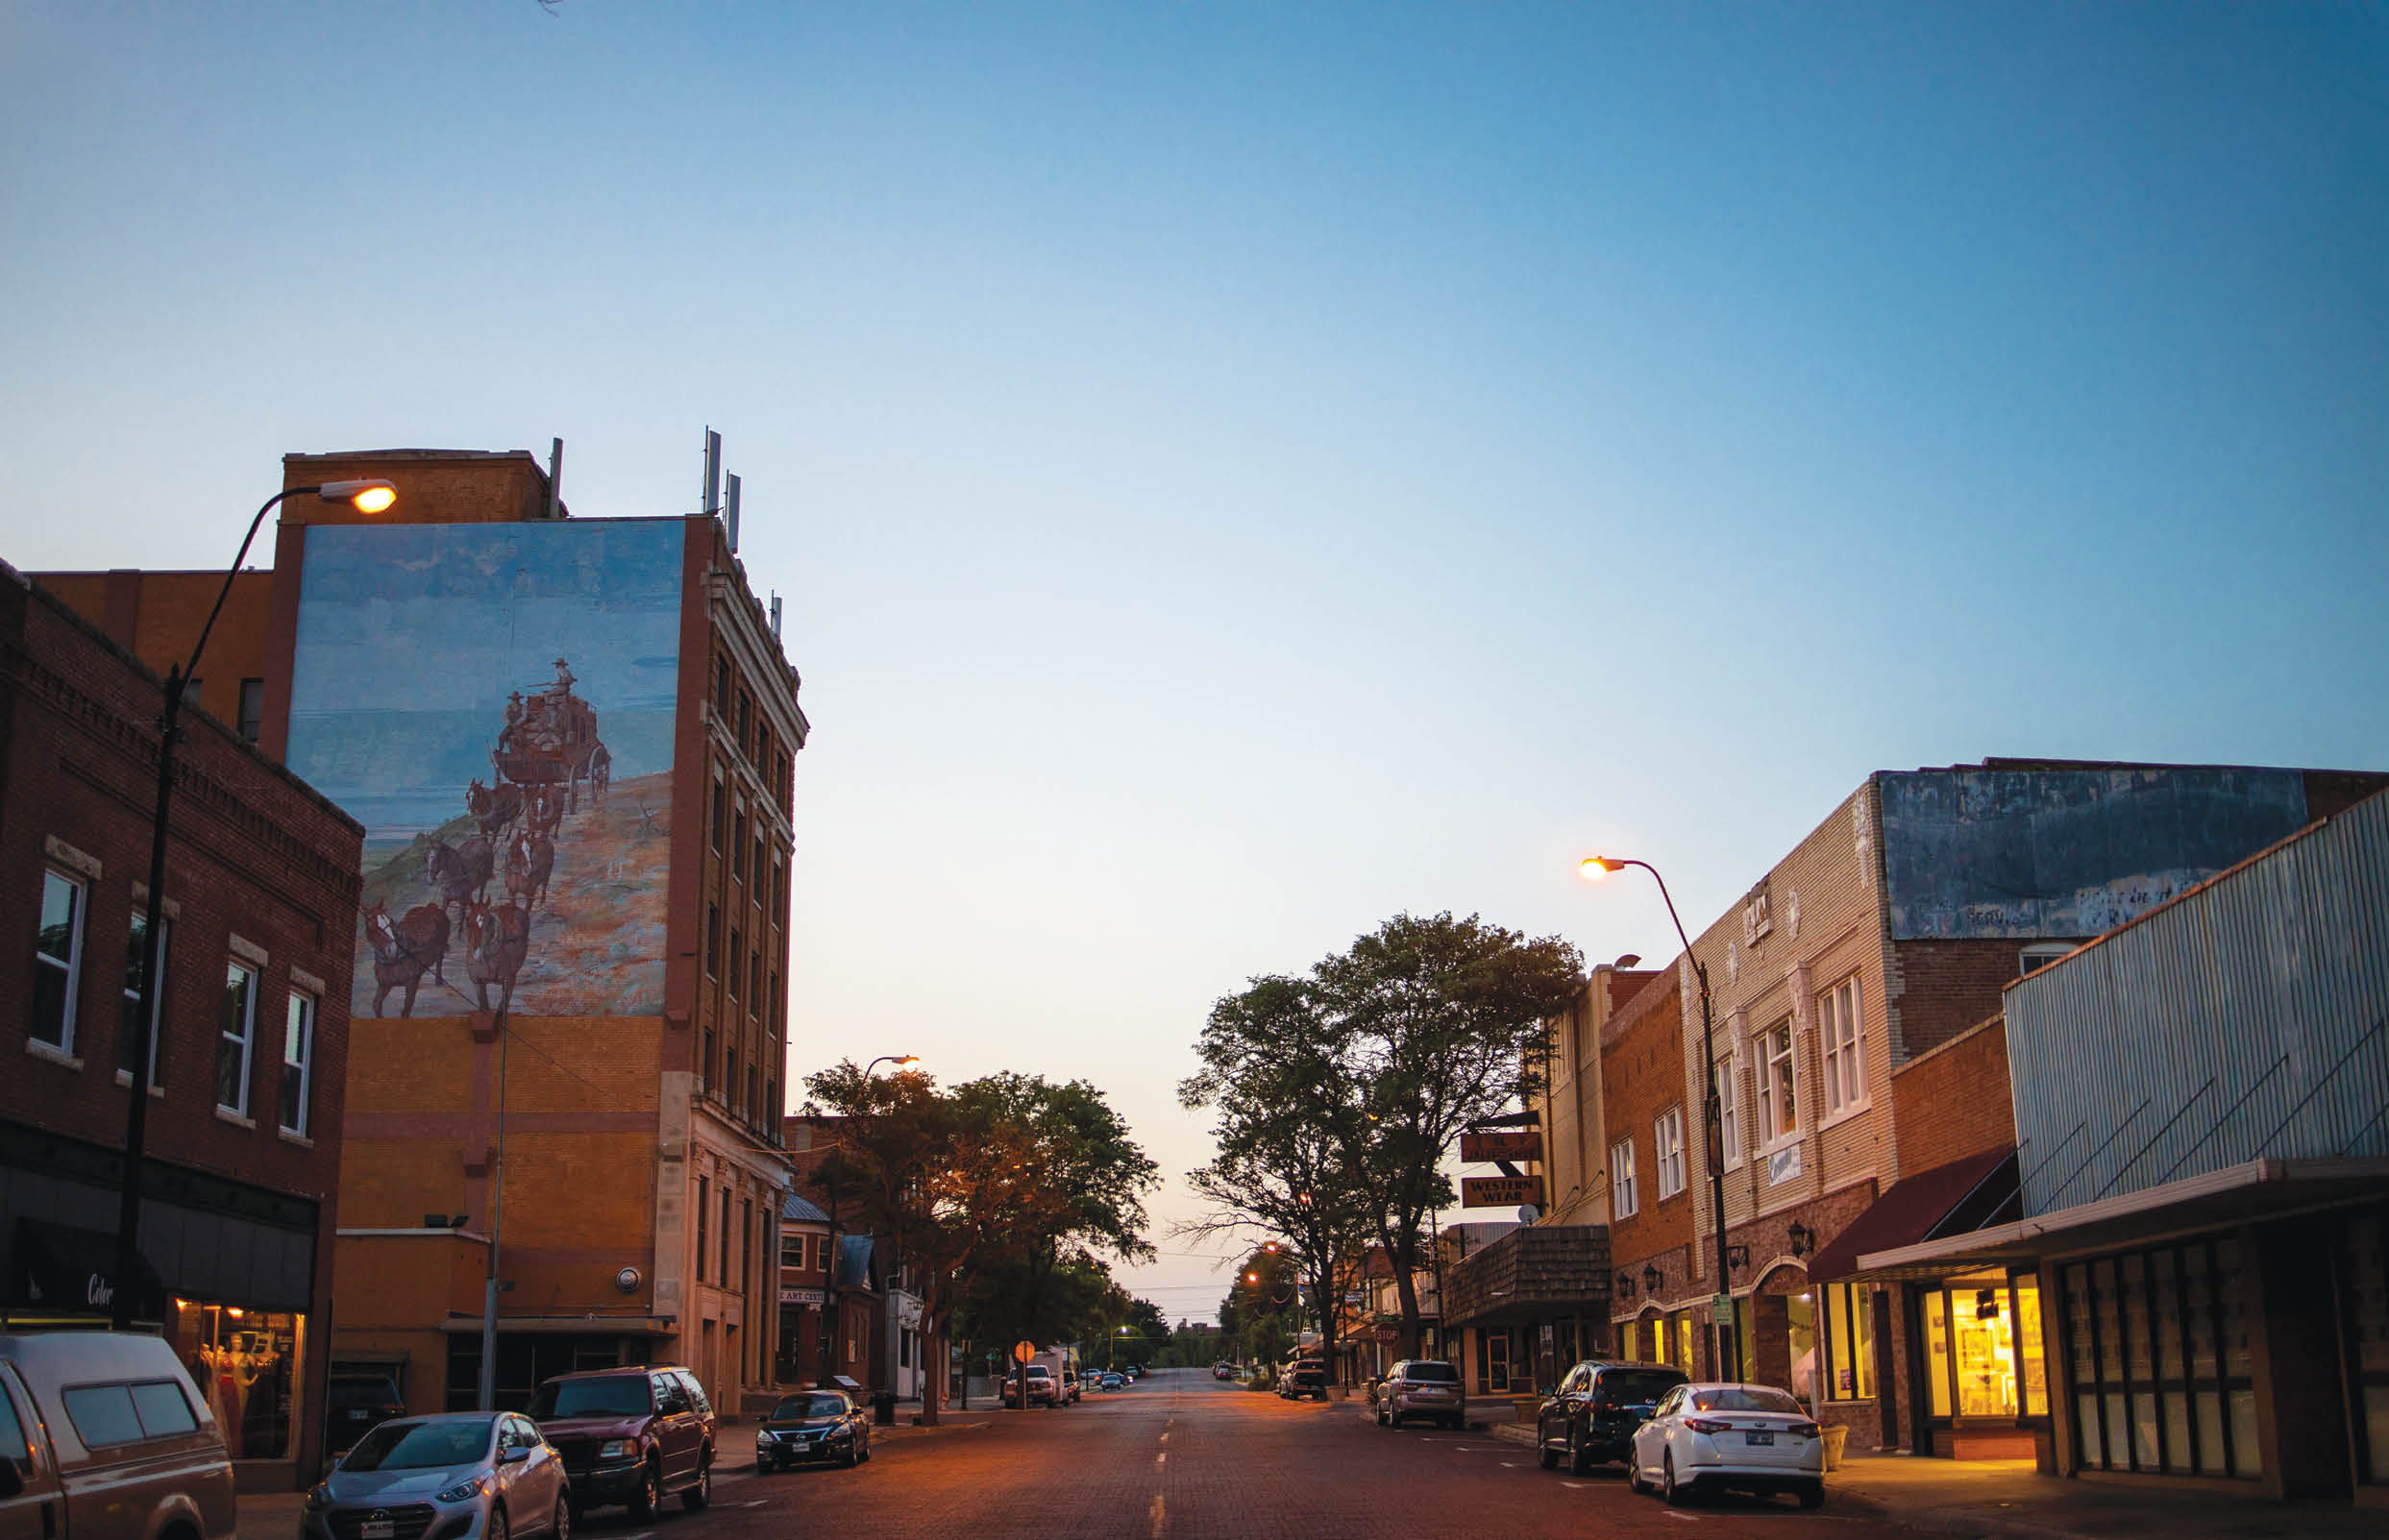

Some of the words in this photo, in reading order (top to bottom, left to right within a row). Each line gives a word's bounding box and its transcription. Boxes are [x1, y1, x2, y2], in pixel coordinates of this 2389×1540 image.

[1470, 1180, 1533, 1191] WESTERN
[1483, 1191, 1522, 1202] WEAR
[1377, 1330, 1397, 1339] STOP
